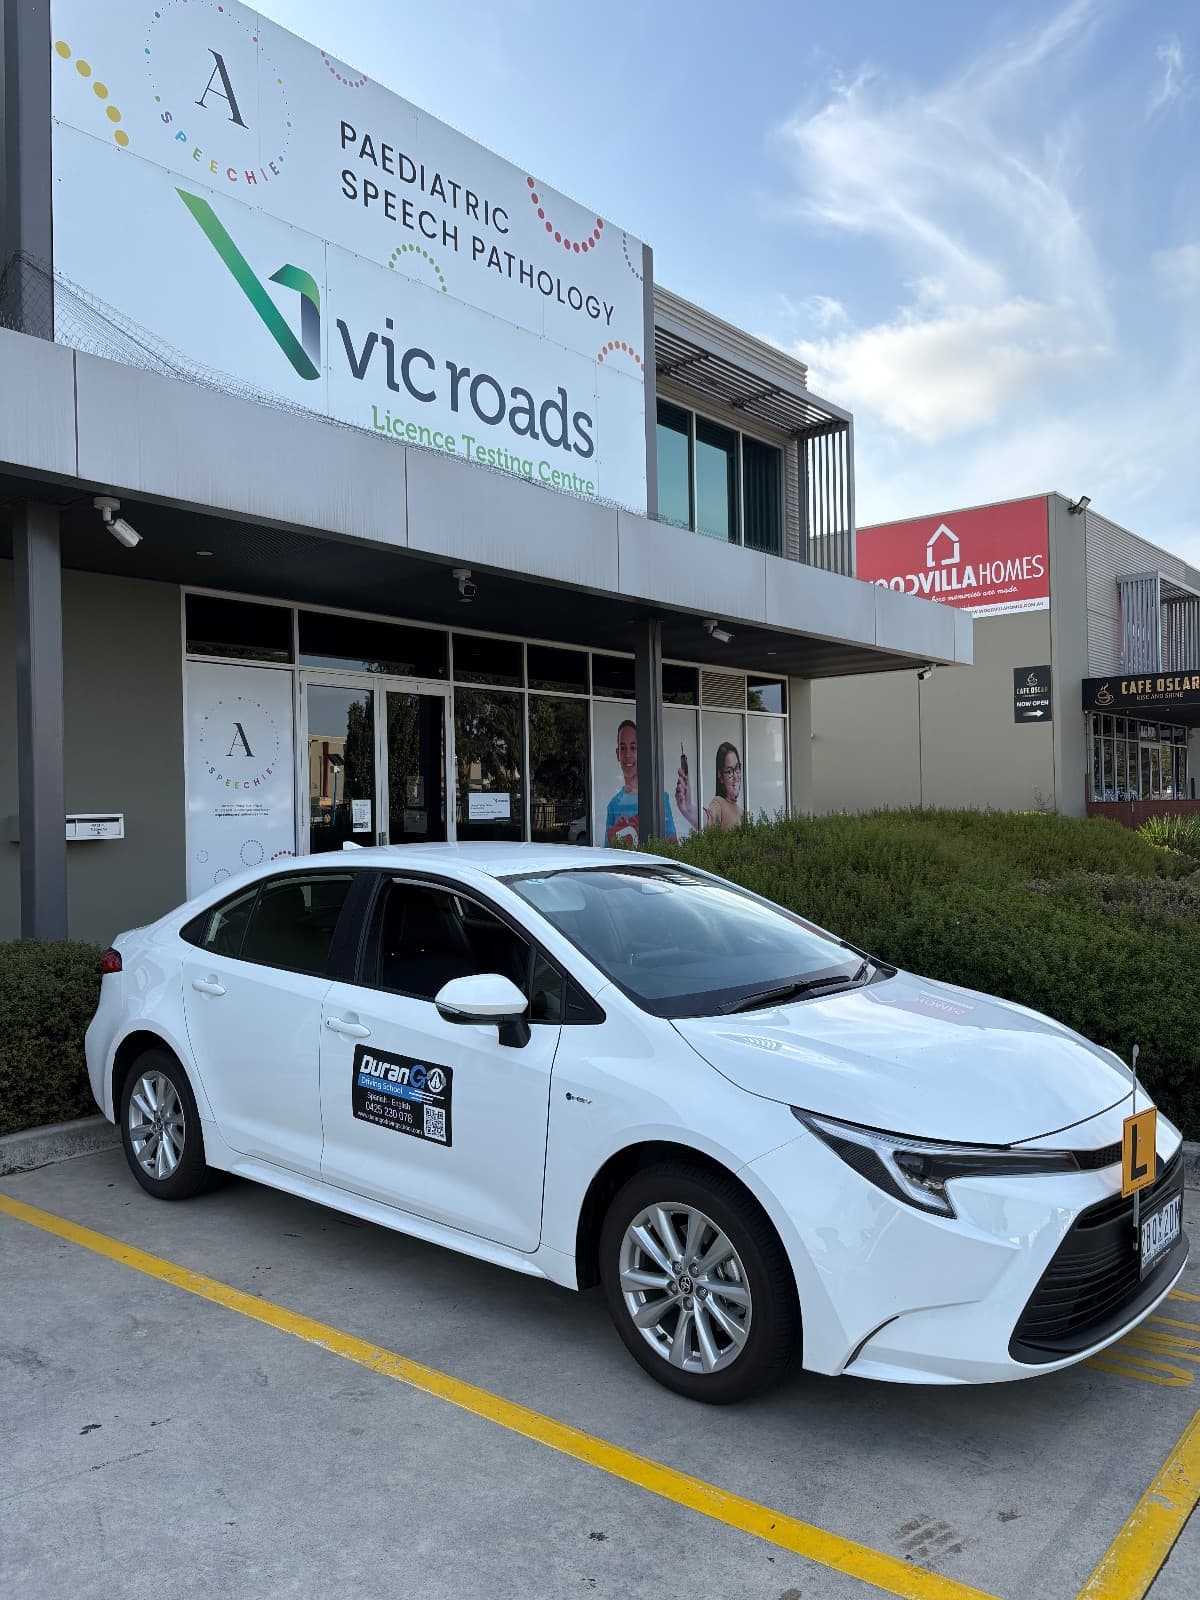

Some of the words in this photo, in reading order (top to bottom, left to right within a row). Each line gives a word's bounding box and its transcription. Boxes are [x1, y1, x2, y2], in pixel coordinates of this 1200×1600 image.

[195, 48, 249, 129] A
[161, 111, 280, 184] SPEECHIE
[341, 120, 508, 234] PAEDIATRIC
[341, 170, 458, 252] SPEECH
[472, 236, 614, 325] PATHOLOGY
[372, 405, 456, 452] Licence
[462, 434, 533, 482] Testing
[538, 460, 594, 496] Centre
[1121, 680, 1152, 694] CAFE
[1156, 676, 1200, 692] OSCAR
[225, 722, 255, 758] A
[209, 766, 272, 789] SPEECHIE
[361, 1076, 382, 1090] Driving
[382, 1082, 402, 1094] School
[365, 1101, 382, 1114] 0425
[384, 1106, 397, 1118] 230
[1131, 1124, 1147, 1180] L
